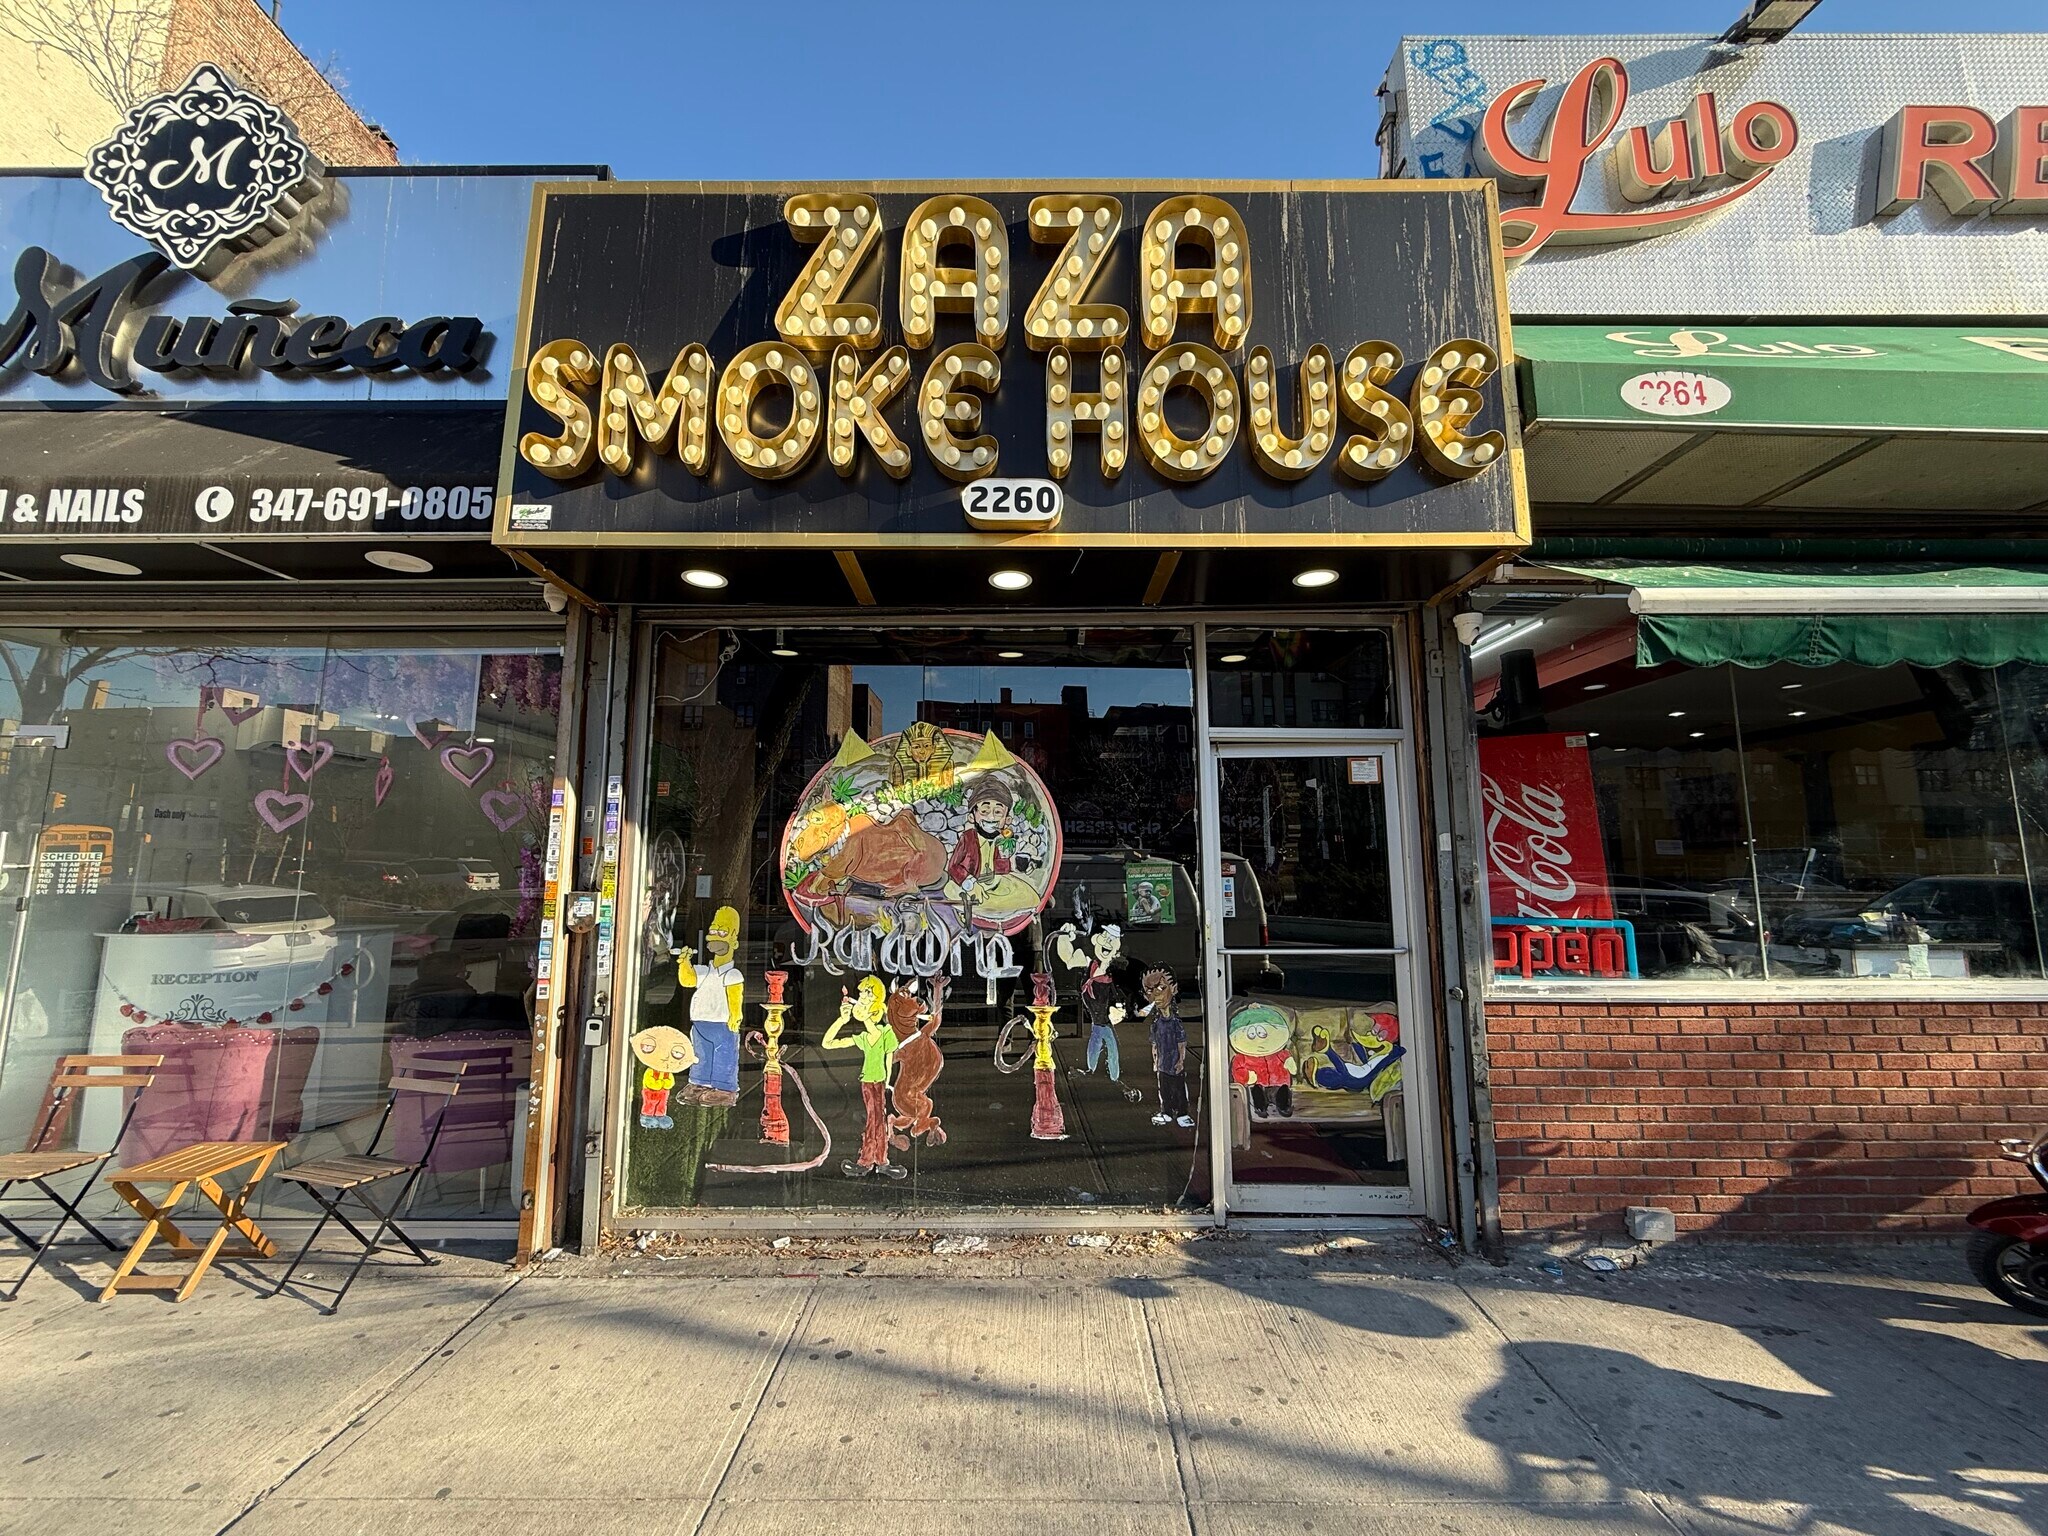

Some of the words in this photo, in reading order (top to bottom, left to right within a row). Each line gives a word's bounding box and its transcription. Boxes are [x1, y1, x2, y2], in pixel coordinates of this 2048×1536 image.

[149, 136, 246, 189] M
[1482, 57, 1799, 264] Lulo
[775, 193, 1252, 352] ZAZA
[0, 246, 484, 396] Muñeca
[1604, 330, 1888, 358] Lulo
[520, 339, 1001, 482] SMOKE
[1045, 338, 1506, 482] HOUSE
[12, 493, 39, 523] &
[46, 489, 145, 523] NAILS
[249, 486, 493, 522] 347-691-0805
[970, 486, 1055, 513] 2260
[42, 853, 101, 861] SCHEDULE
[151, 971, 259, 985] RECEPTION
